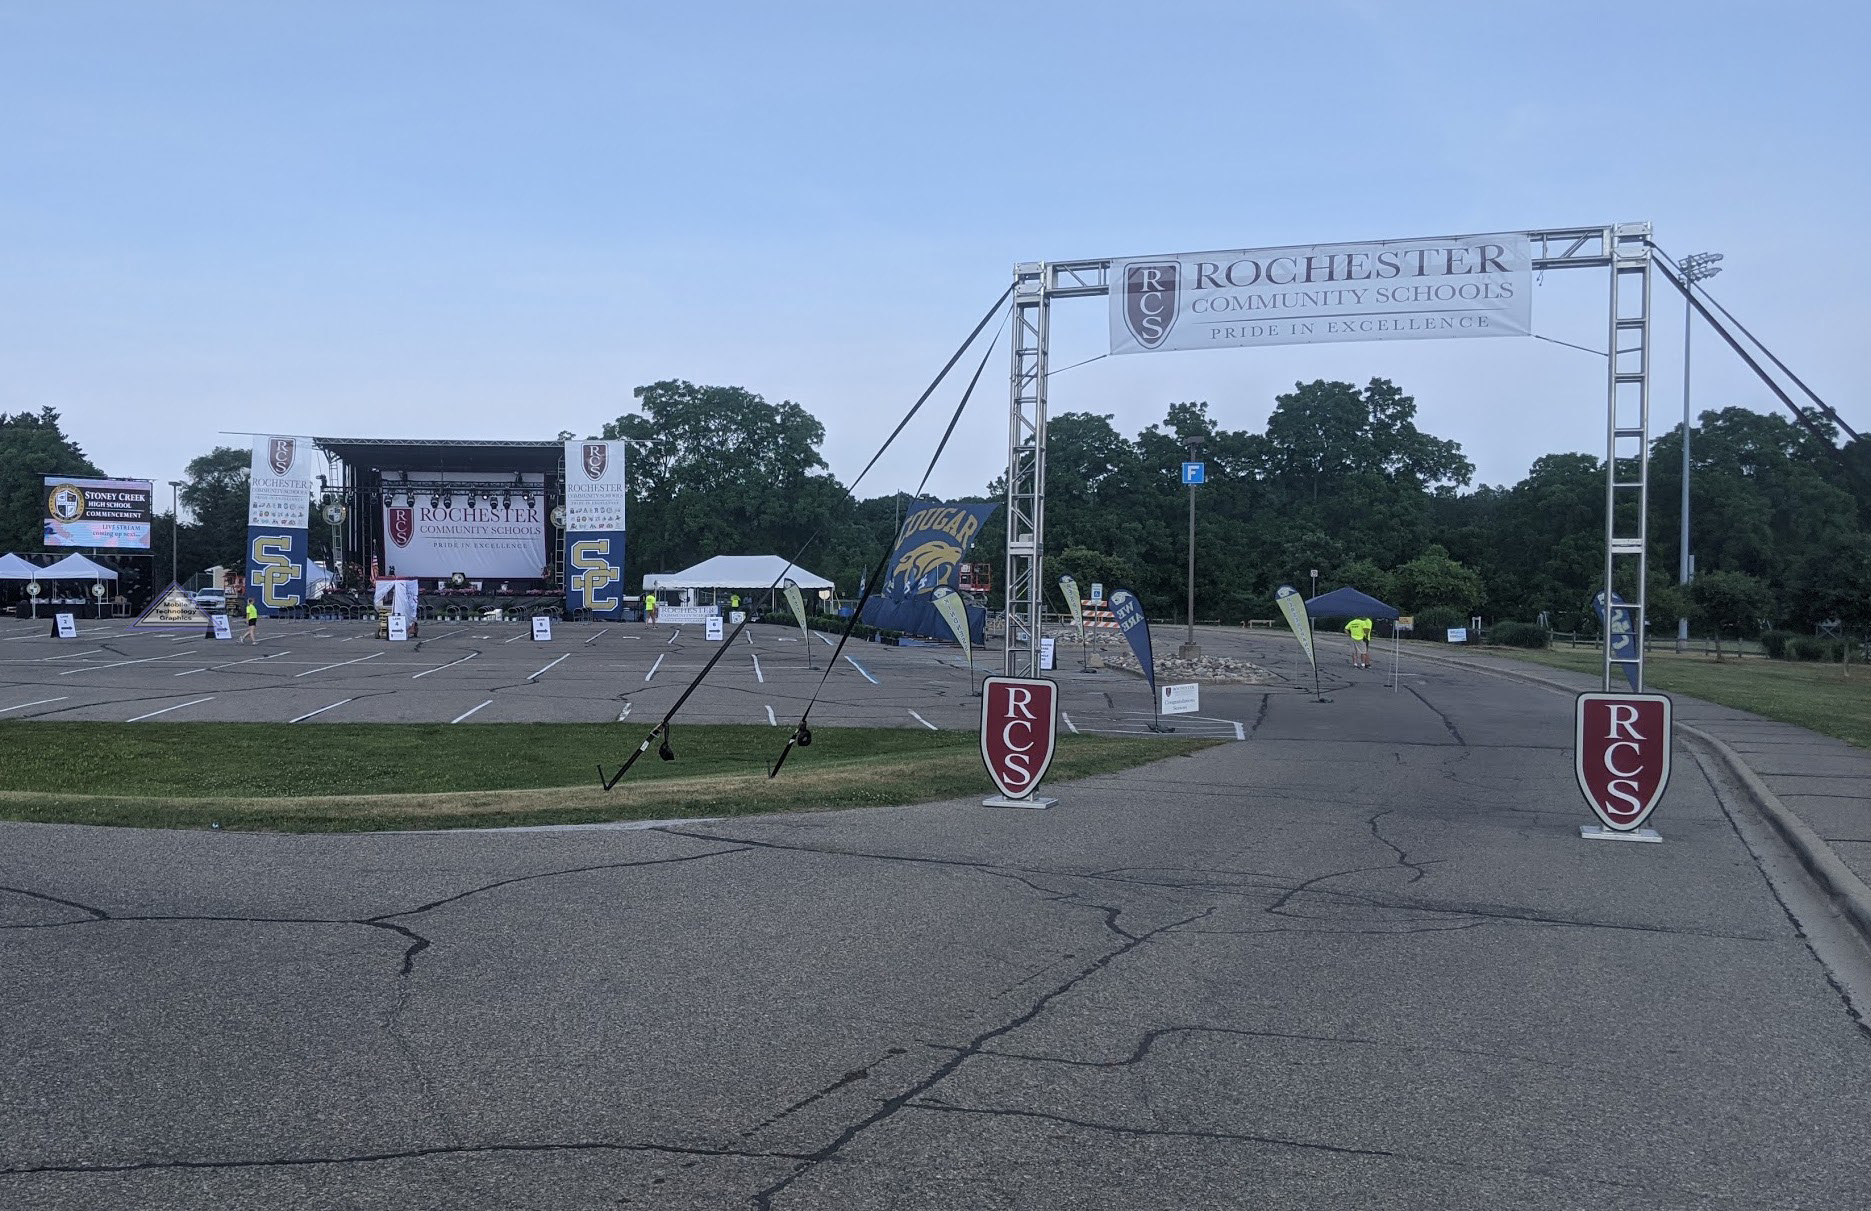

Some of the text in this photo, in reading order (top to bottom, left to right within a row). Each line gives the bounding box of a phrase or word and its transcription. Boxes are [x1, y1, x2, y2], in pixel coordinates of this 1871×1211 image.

[1191, 244, 1514, 290] ROCHESTER
[1140, 269, 1166, 339] RCS
[1191, 281, 1515, 314] COMMUNITY SCHOOLS
[1209, 316, 1490, 340] PRIDE IN EXCELLENCE
[275, 440, 289, 473] RCS
[589, 445, 604, 478] RCS
[1187, 465, 1200, 481] F
[84, 491, 146, 502] STONEY CREEK
[252, 477, 308, 490] ROCHESTER
[567, 483, 623, 493] ROCHESTER
[395, 509, 408, 544] RCS
[419, 507, 540, 523] ROCHESTER
[419, 525, 541, 535] COMMUNITY SCHOOLS
[1002, 687, 1038, 786] RCS
[1603, 704, 1648, 816] RCS
